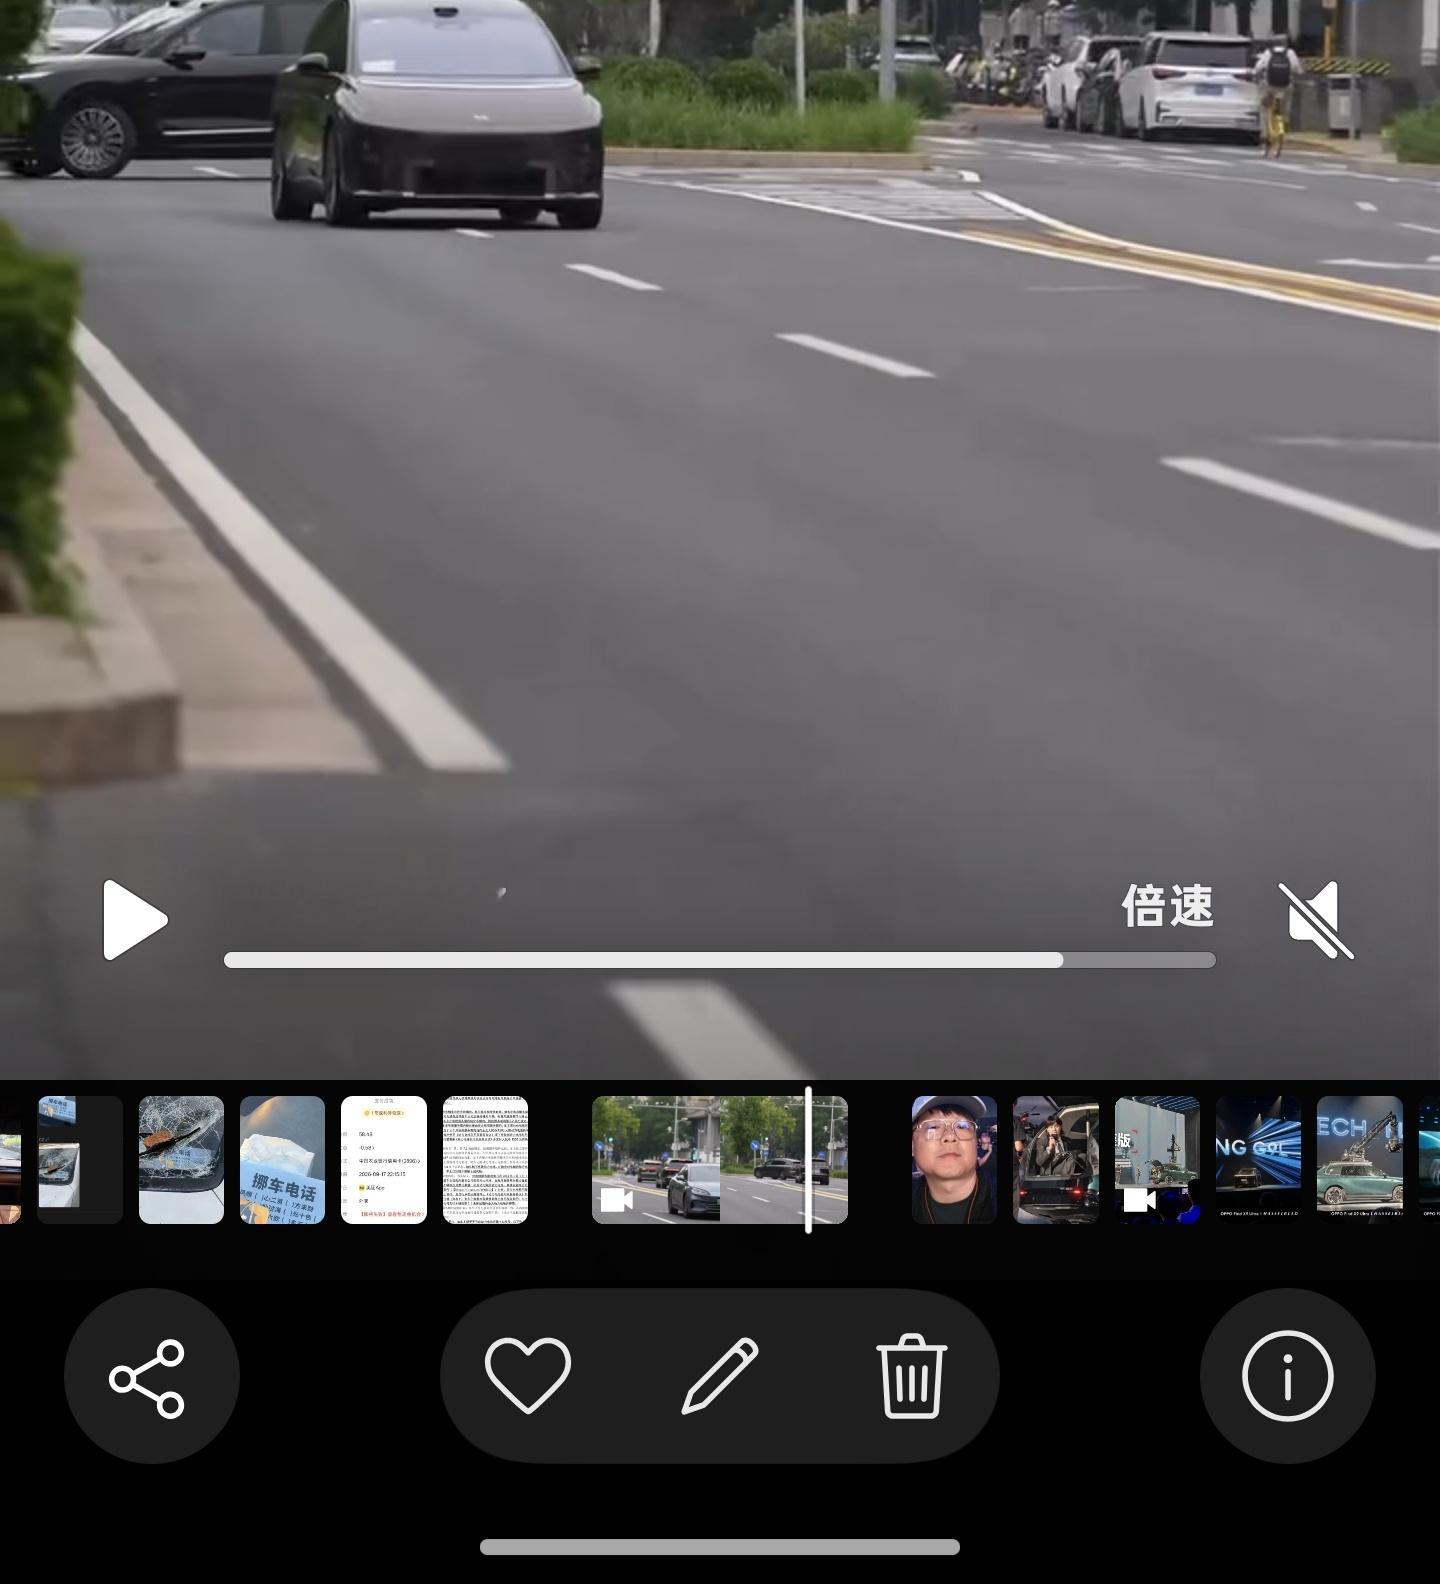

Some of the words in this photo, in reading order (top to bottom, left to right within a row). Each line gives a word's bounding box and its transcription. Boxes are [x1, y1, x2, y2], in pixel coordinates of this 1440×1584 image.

[1216, 1138, 1247, 1156] NG
[252, 1172, 317, 1202] 挪车电话
